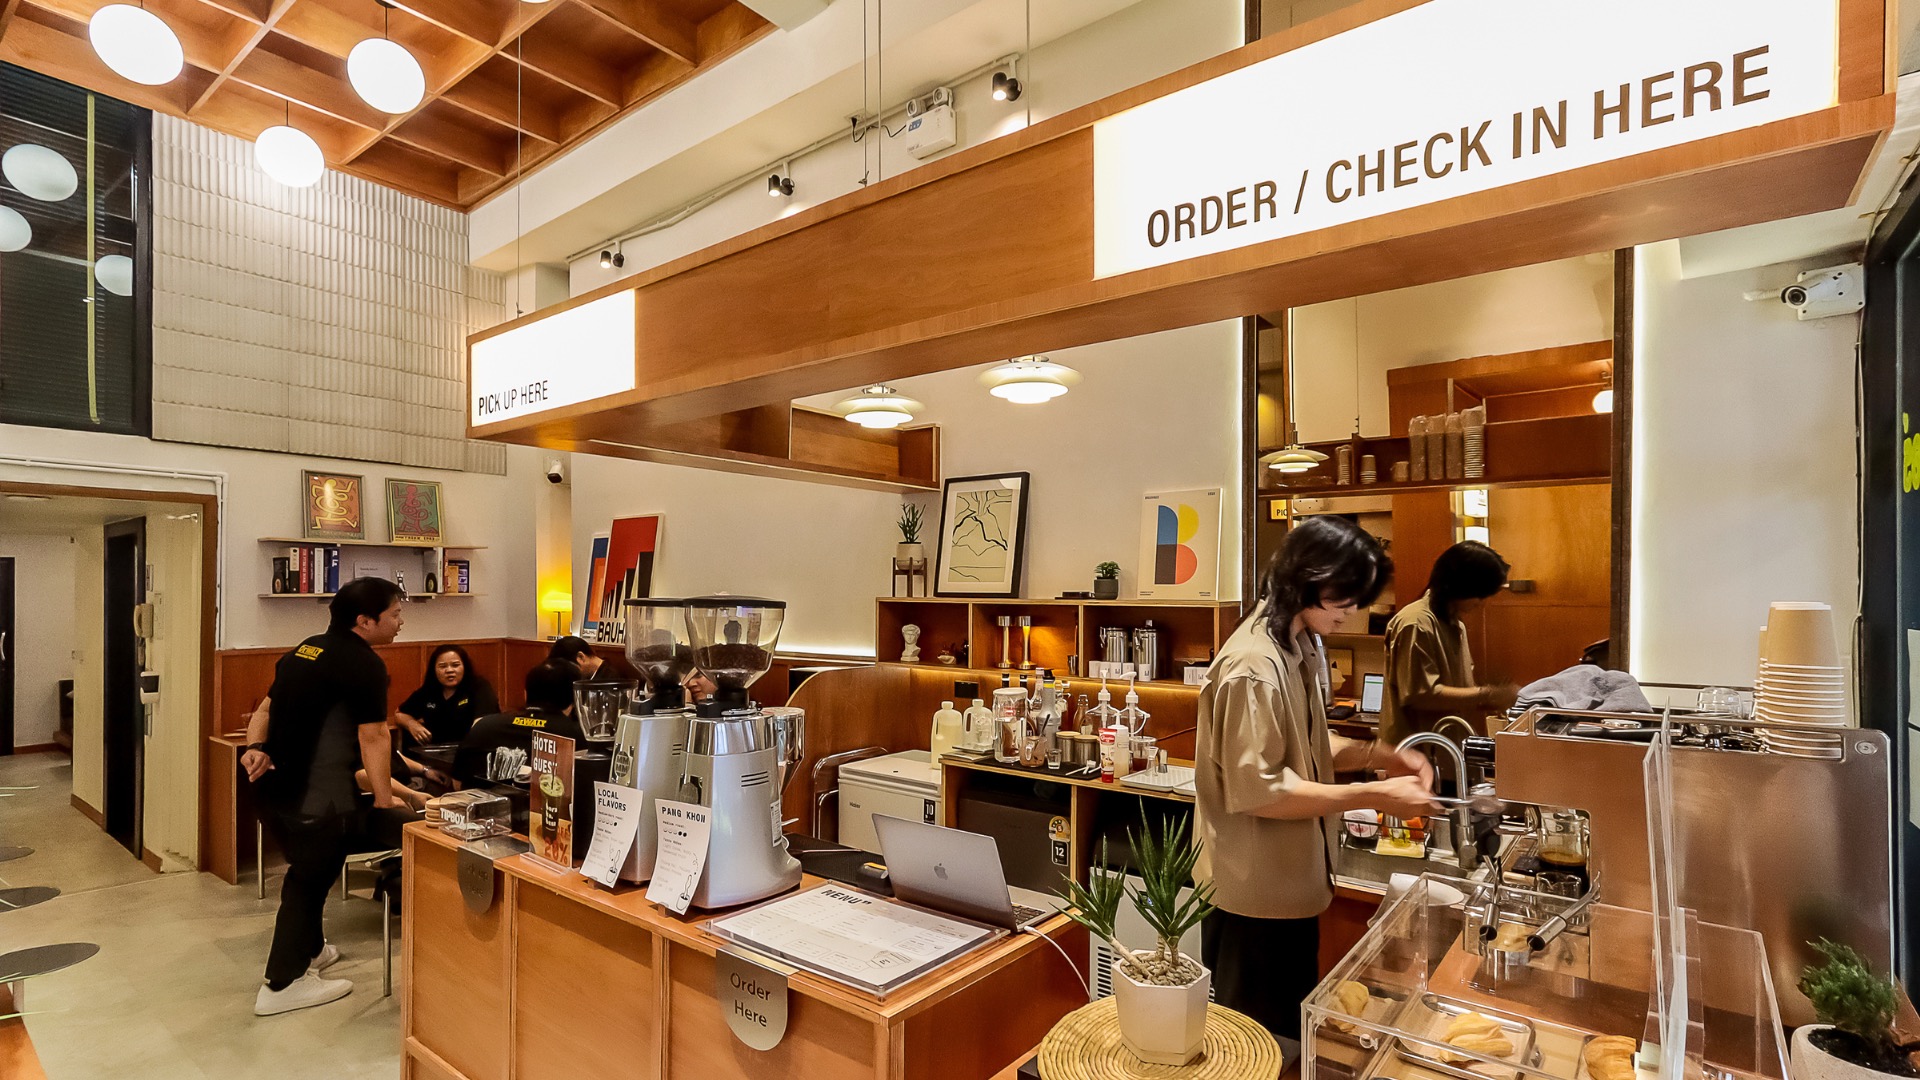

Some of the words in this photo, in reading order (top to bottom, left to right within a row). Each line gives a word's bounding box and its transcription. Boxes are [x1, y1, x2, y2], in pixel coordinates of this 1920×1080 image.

[1147, 180, 1277, 248] ORDER
[1294, 169, 1309, 215] /
[1325, 119, 1493, 204] CHECK
[1512, 99, 1567, 159] IN
[1593, 44, 1770, 140] HERE
[478, 393, 500, 416] PICK
[504, 388, 517, 409] UP
[520, 380, 548, 405] HERE
[597, 621, 626, 644] BAUH
[534, 736, 557, 755] HOTEL
[597, 788, 620, 800] LOCAL
[598, 798, 627, 812] FLAVORS
[440, 808, 466, 827] TIPBOX
[661, 806, 682, 818] PANG
[686, 811, 706, 824] KHON
[1054, 846, 1065, 857] 12
[730, 972, 771, 1001] Order
[734, 1000, 767, 1028] Here
